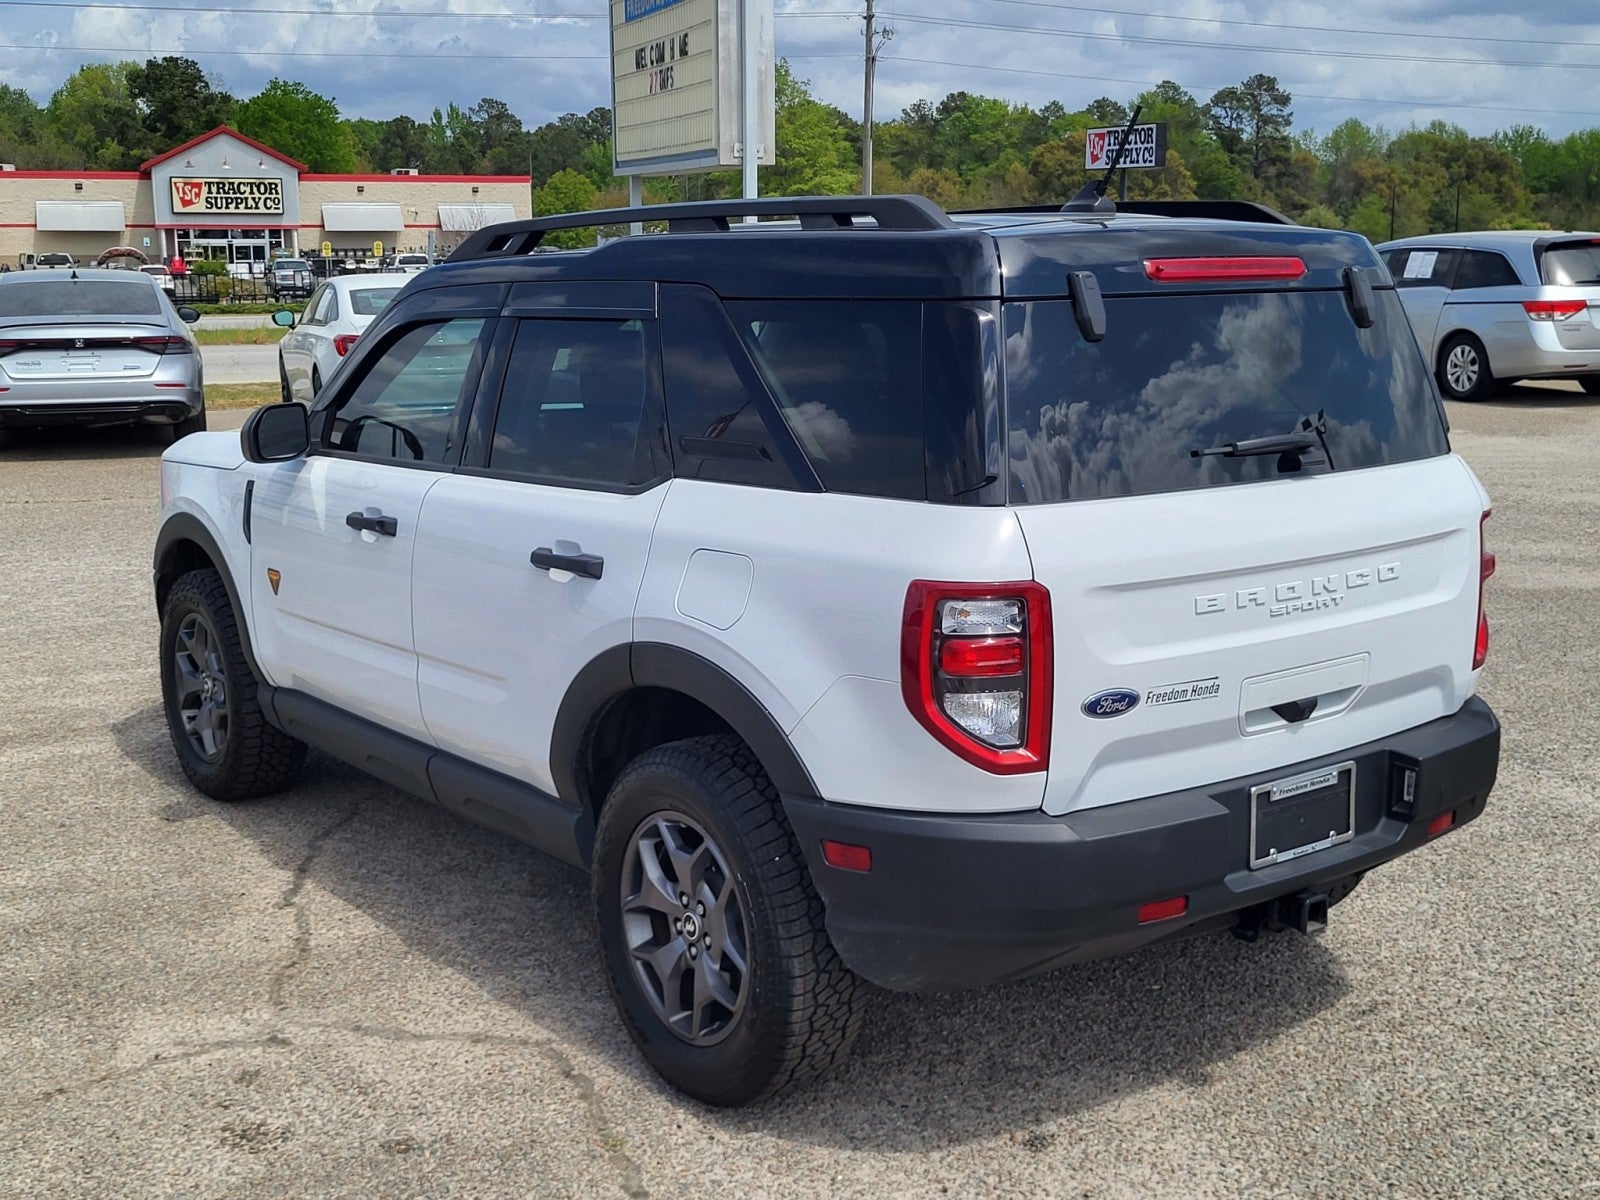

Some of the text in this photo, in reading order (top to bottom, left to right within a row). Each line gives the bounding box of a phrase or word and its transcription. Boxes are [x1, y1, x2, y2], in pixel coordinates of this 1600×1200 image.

[1089, 134, 1104, 159] TSC
[176, 182, 199, 203] TSC
[204, 181, 280, 195] TRACTOR
[205, 196, 260, 210] SUPPLY
[1195, 562, 1401, 615] BRONCO
[1269, 595, 1344, 618] SPORT
[1145, 681, 1221, 705] Freedom Honda
[1096, 695, 1130, 713] Ford
[1279, 783, 1309, 796] Freedom
